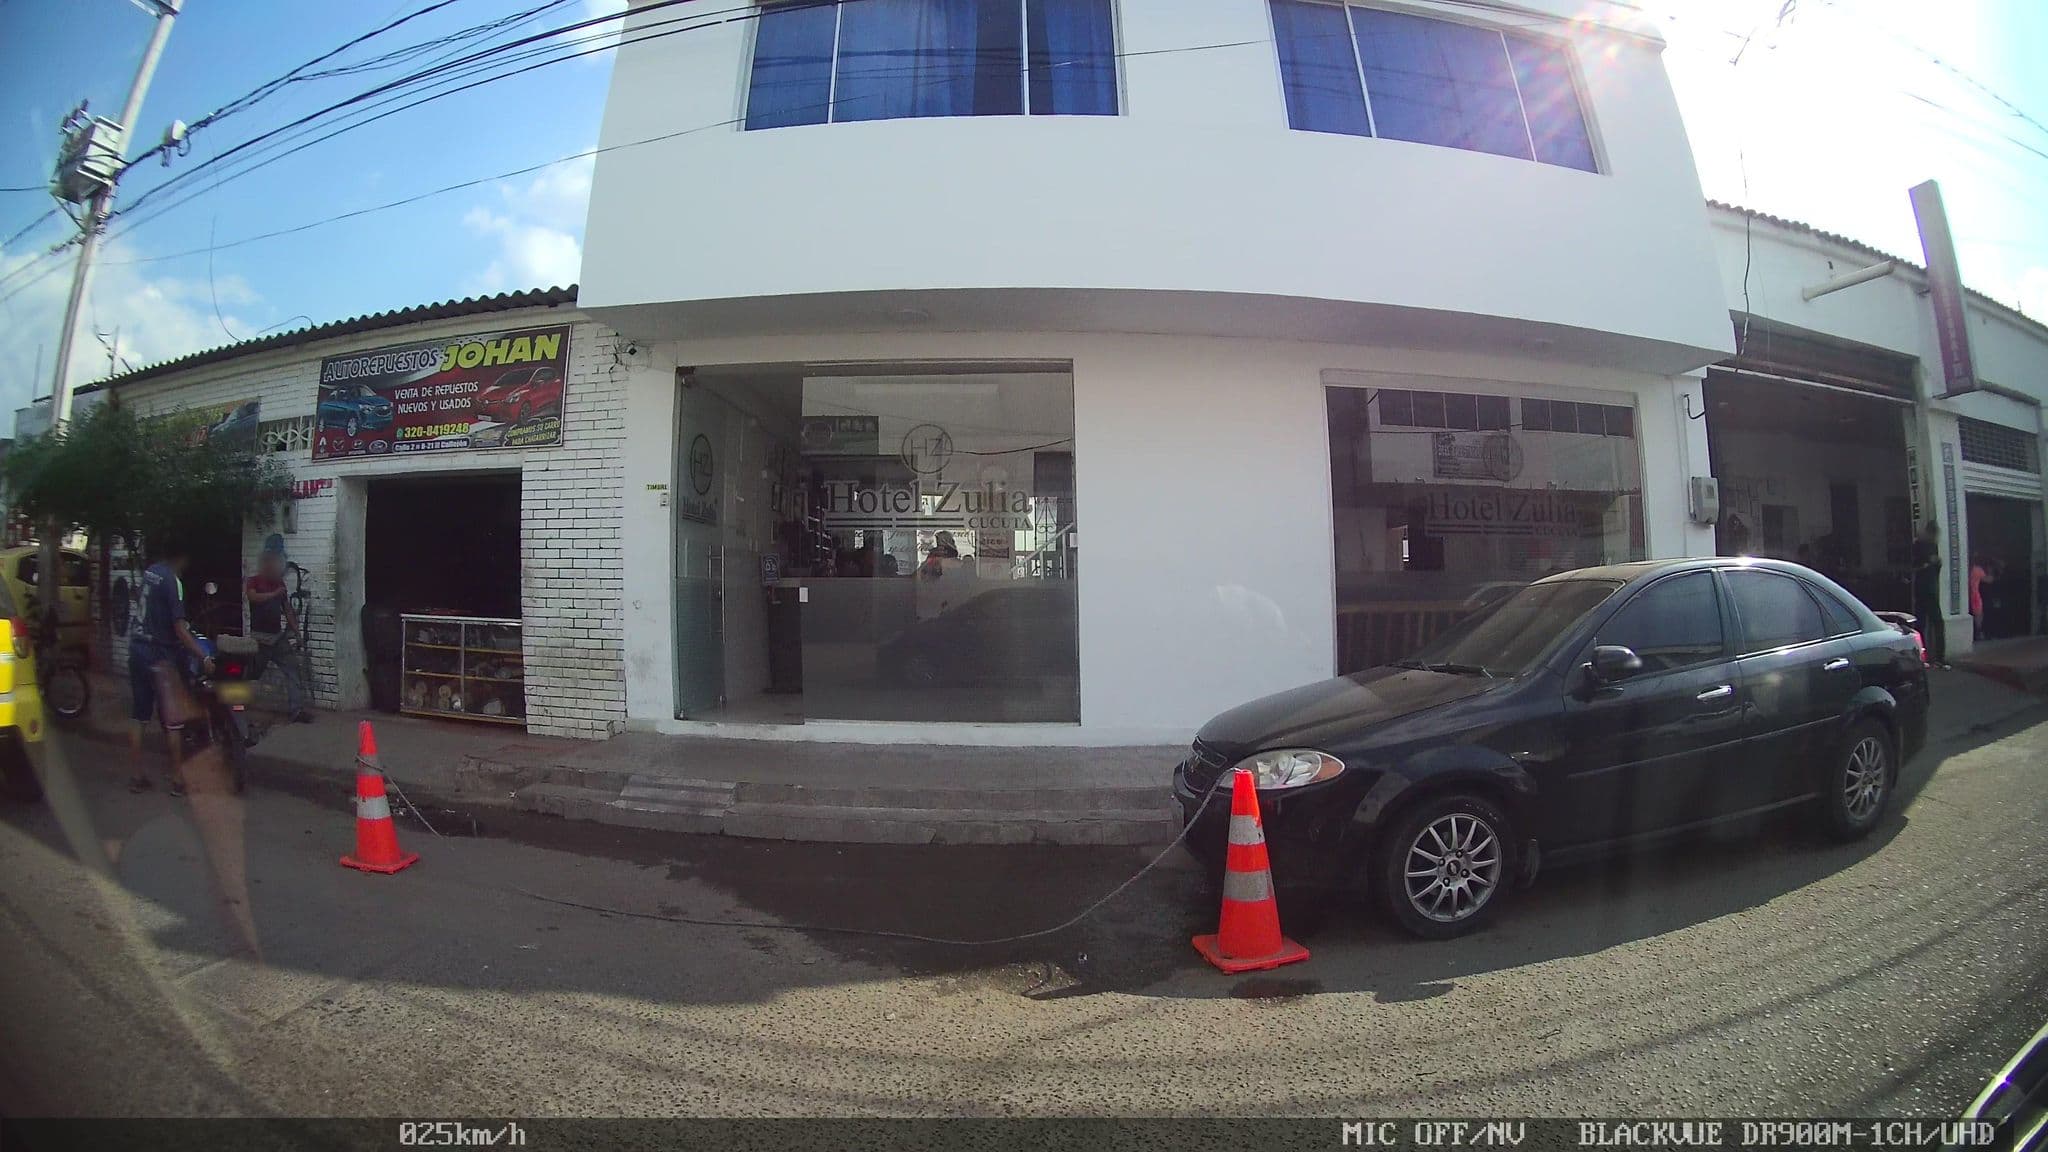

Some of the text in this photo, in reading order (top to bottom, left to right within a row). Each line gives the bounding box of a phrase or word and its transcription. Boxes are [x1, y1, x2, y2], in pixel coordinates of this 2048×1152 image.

[323, 333, 561, 382] AUTOREPUESTOS JOHAN
[395, 381, 479, 400] VENTA DE REPUESTOS
[397, 397, 472, 414] NUEVOS Y USADOS
[404, 422, 470, 438] 320-8419248
[826, 480, 1032, 514] Hotel Zulia
[1428, 491, 1577, 522] Hotel Zulia
